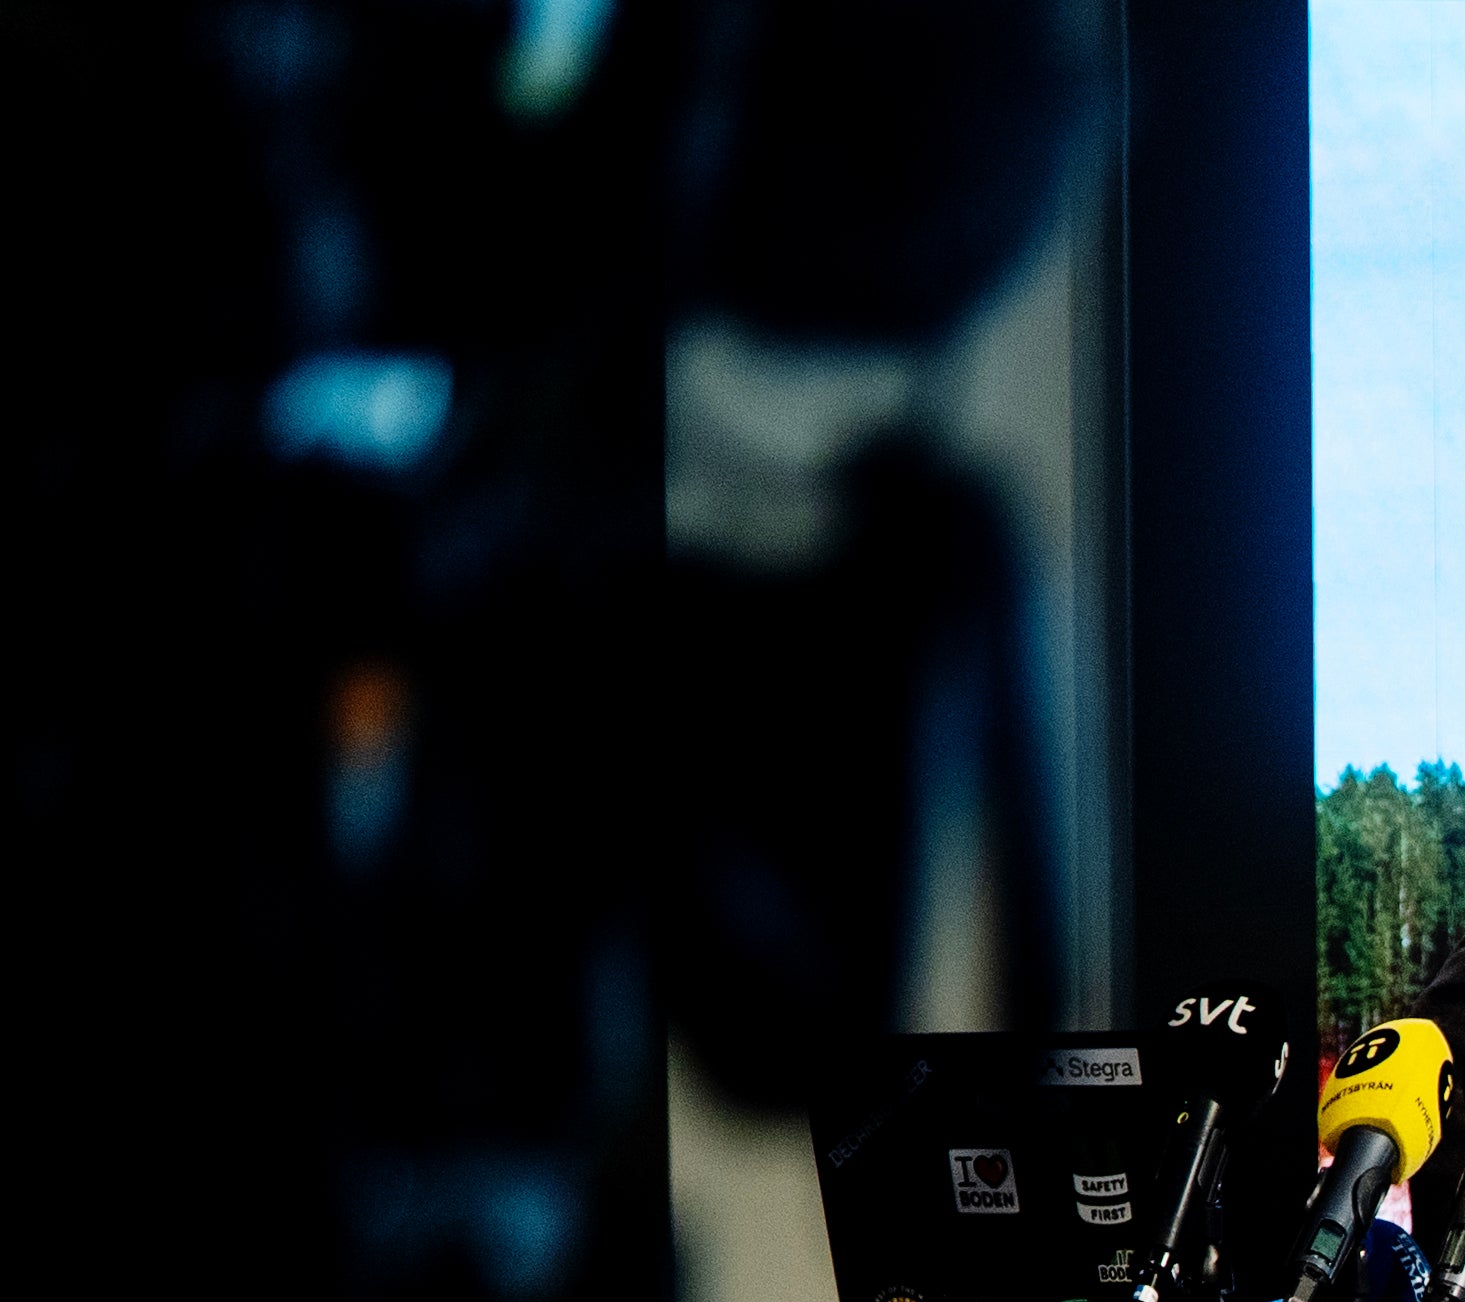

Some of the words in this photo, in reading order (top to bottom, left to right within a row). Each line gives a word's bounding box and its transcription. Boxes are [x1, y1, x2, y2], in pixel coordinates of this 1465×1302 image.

[1168, 996, 1256, 1035] svt
[1068, 1057, 1133, 1082] Stegra
[954, 1156, 977, 1188] I
[1081, 1179, 1126, 1192] SAFETY
[959, 1191, 1015, 1208] BODEN
[1090, 1207, 1126, 1221] FIRST
